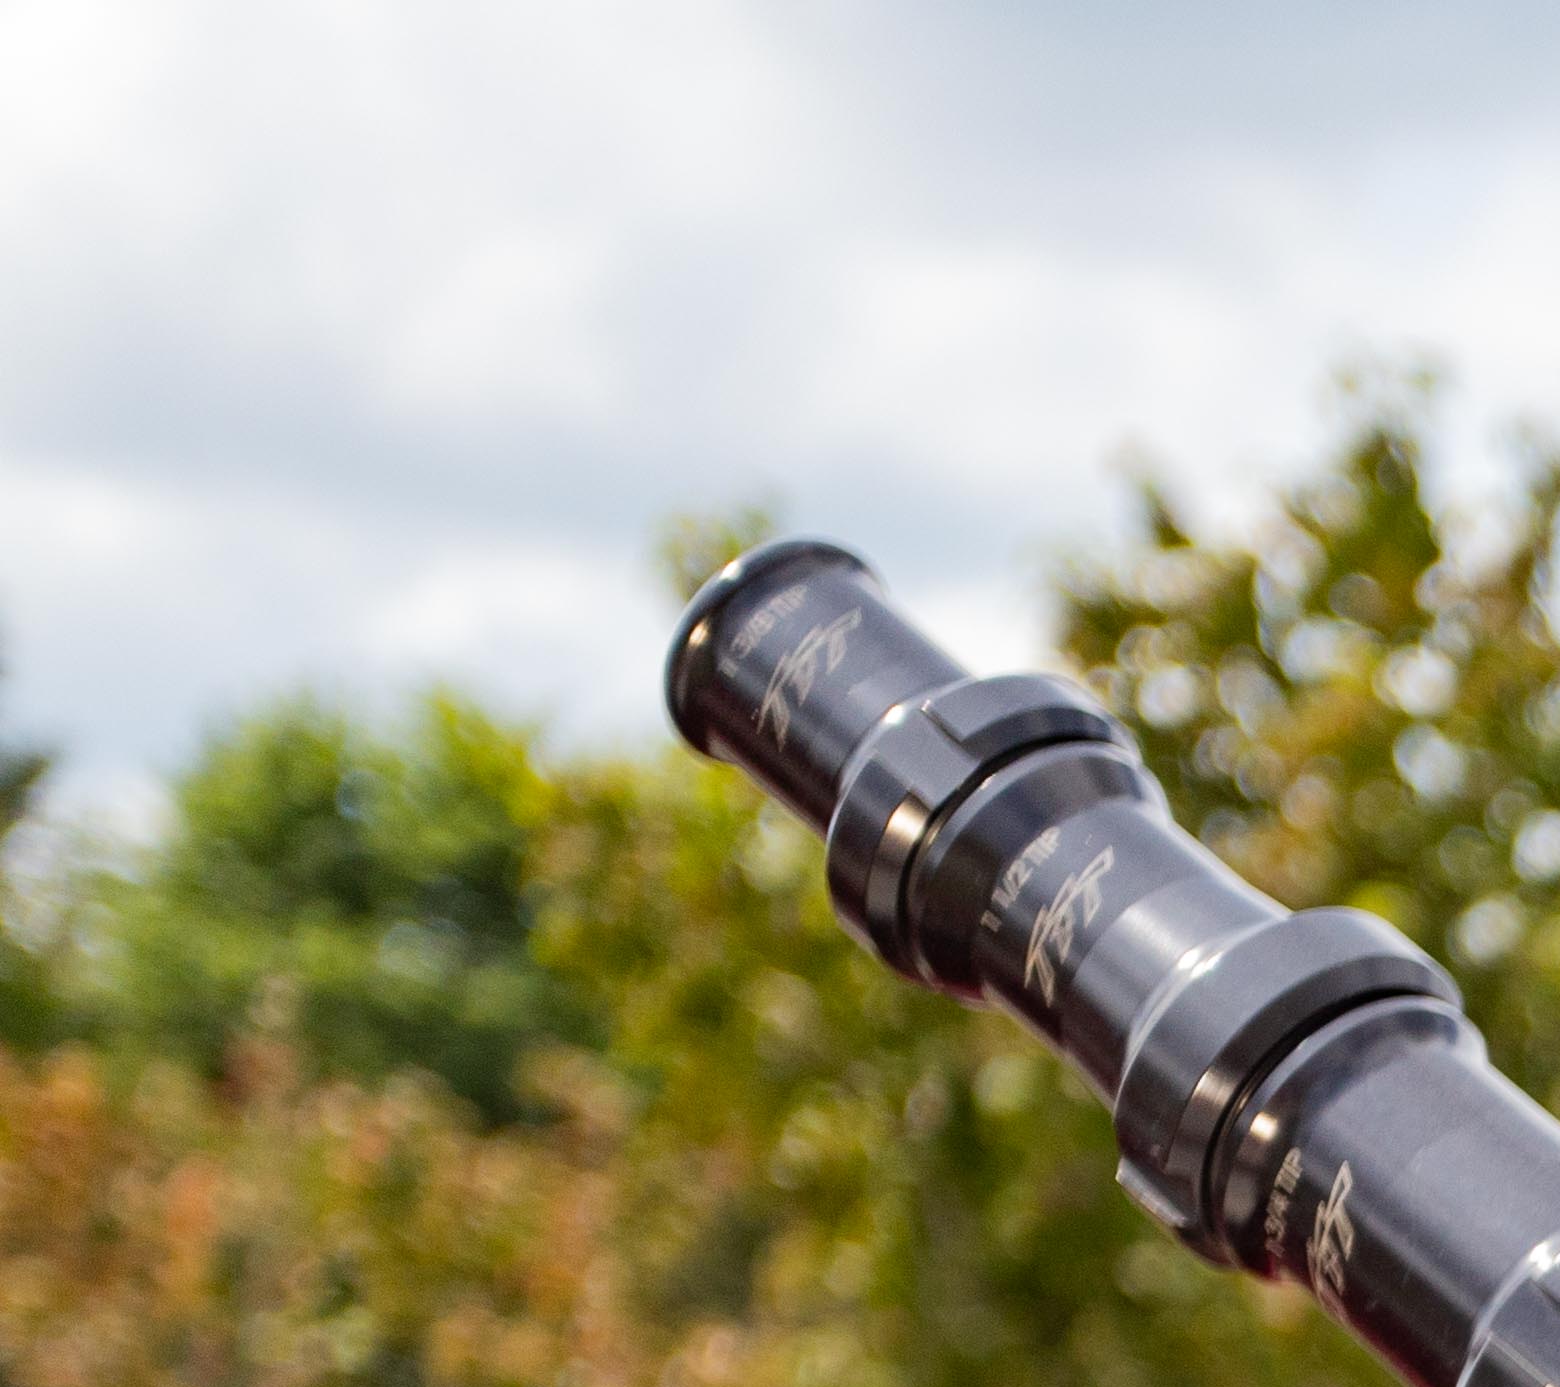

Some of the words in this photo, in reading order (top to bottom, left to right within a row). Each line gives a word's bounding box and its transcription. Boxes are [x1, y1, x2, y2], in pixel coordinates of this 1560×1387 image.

[768, 583, 810, 618] TIP
[991, 857, 1034, 909] 1/2
[1022, 826, 1061, 867] TIP
[1274, 1147, 1303, 1194] TIP
